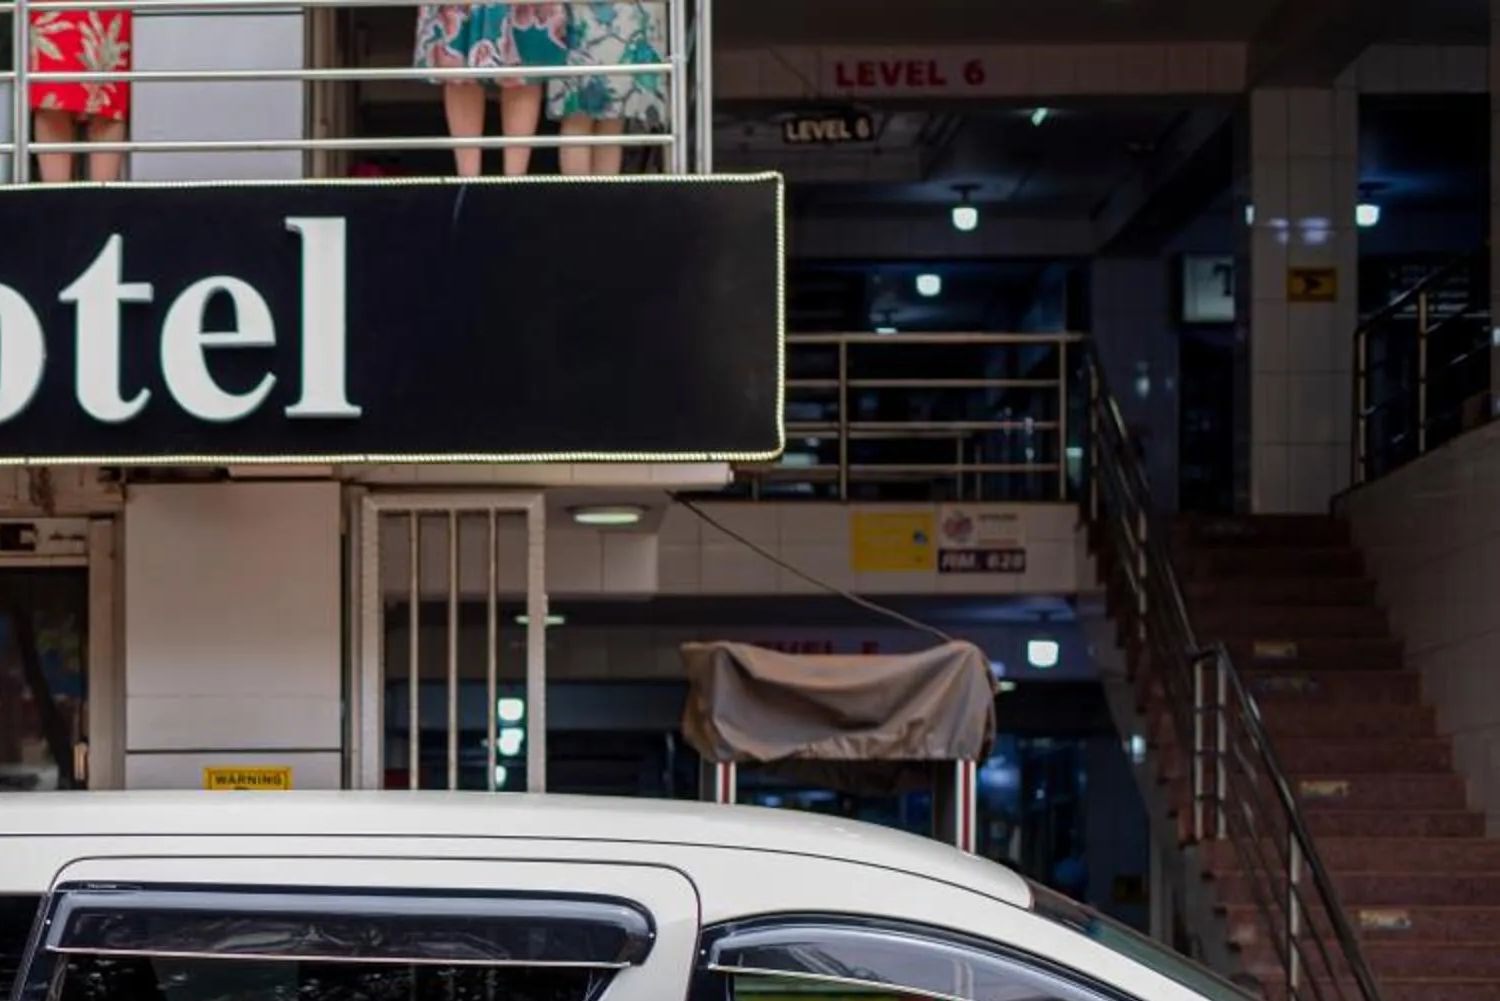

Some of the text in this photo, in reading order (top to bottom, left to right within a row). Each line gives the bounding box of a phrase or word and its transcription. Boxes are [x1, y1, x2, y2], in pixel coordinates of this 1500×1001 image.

[836, 59, 986, 87] LEVEL 6
[786, 118, 852, 141] LEVEL
[215, 774, 283, 786] WARNING
